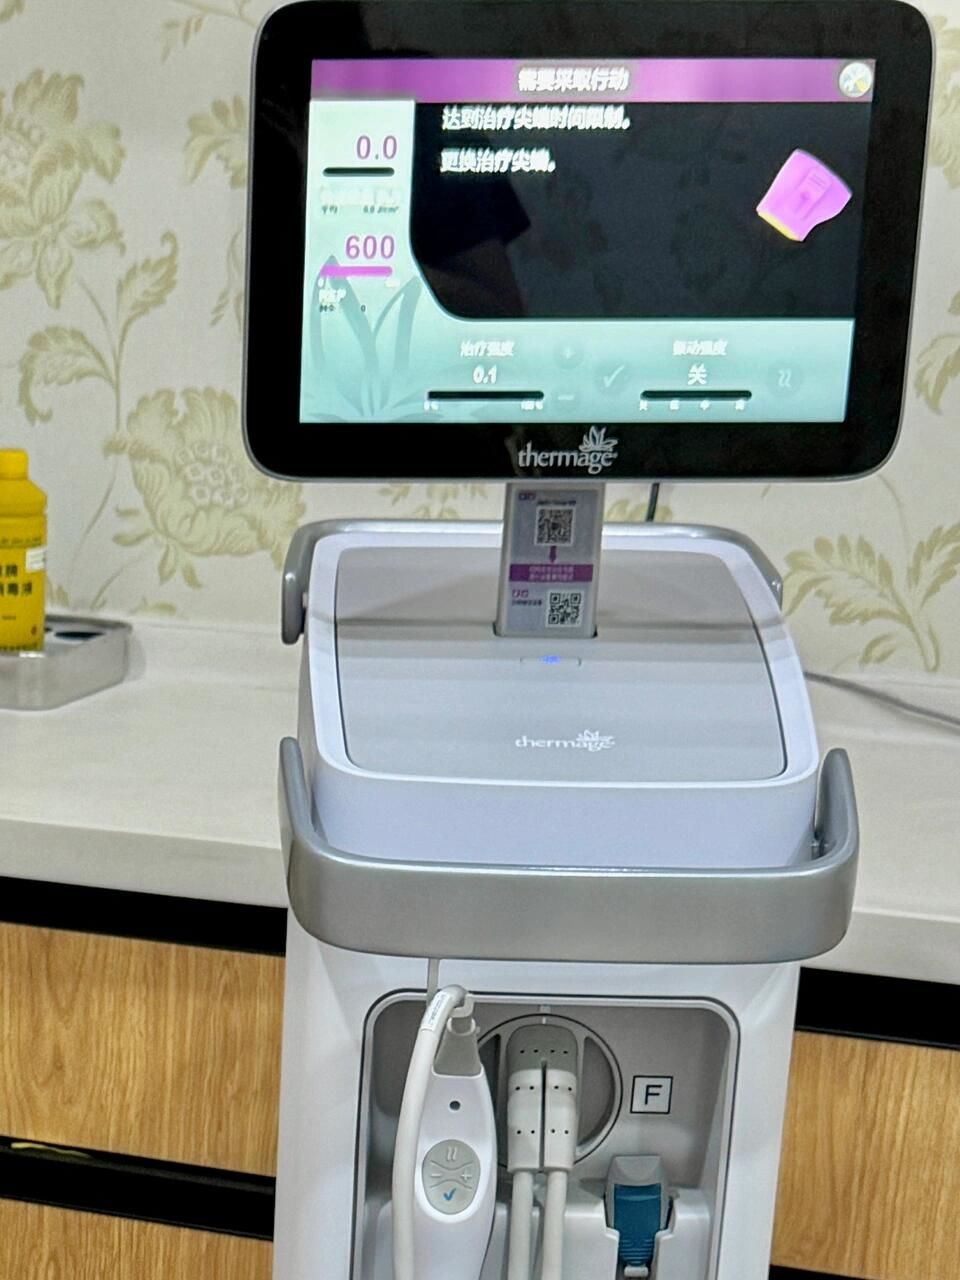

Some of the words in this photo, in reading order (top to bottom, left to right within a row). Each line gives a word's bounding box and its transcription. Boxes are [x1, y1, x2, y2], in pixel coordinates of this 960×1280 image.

[356, 135, 398, 160] 0.0
[345, 235, 395, 260] 600
[472, 365, 497, 384] 0.1
[687, 363, 707, 385] 关
[518, 440, 613, 474] thermage
[644, 1084, 663, 1106] F
